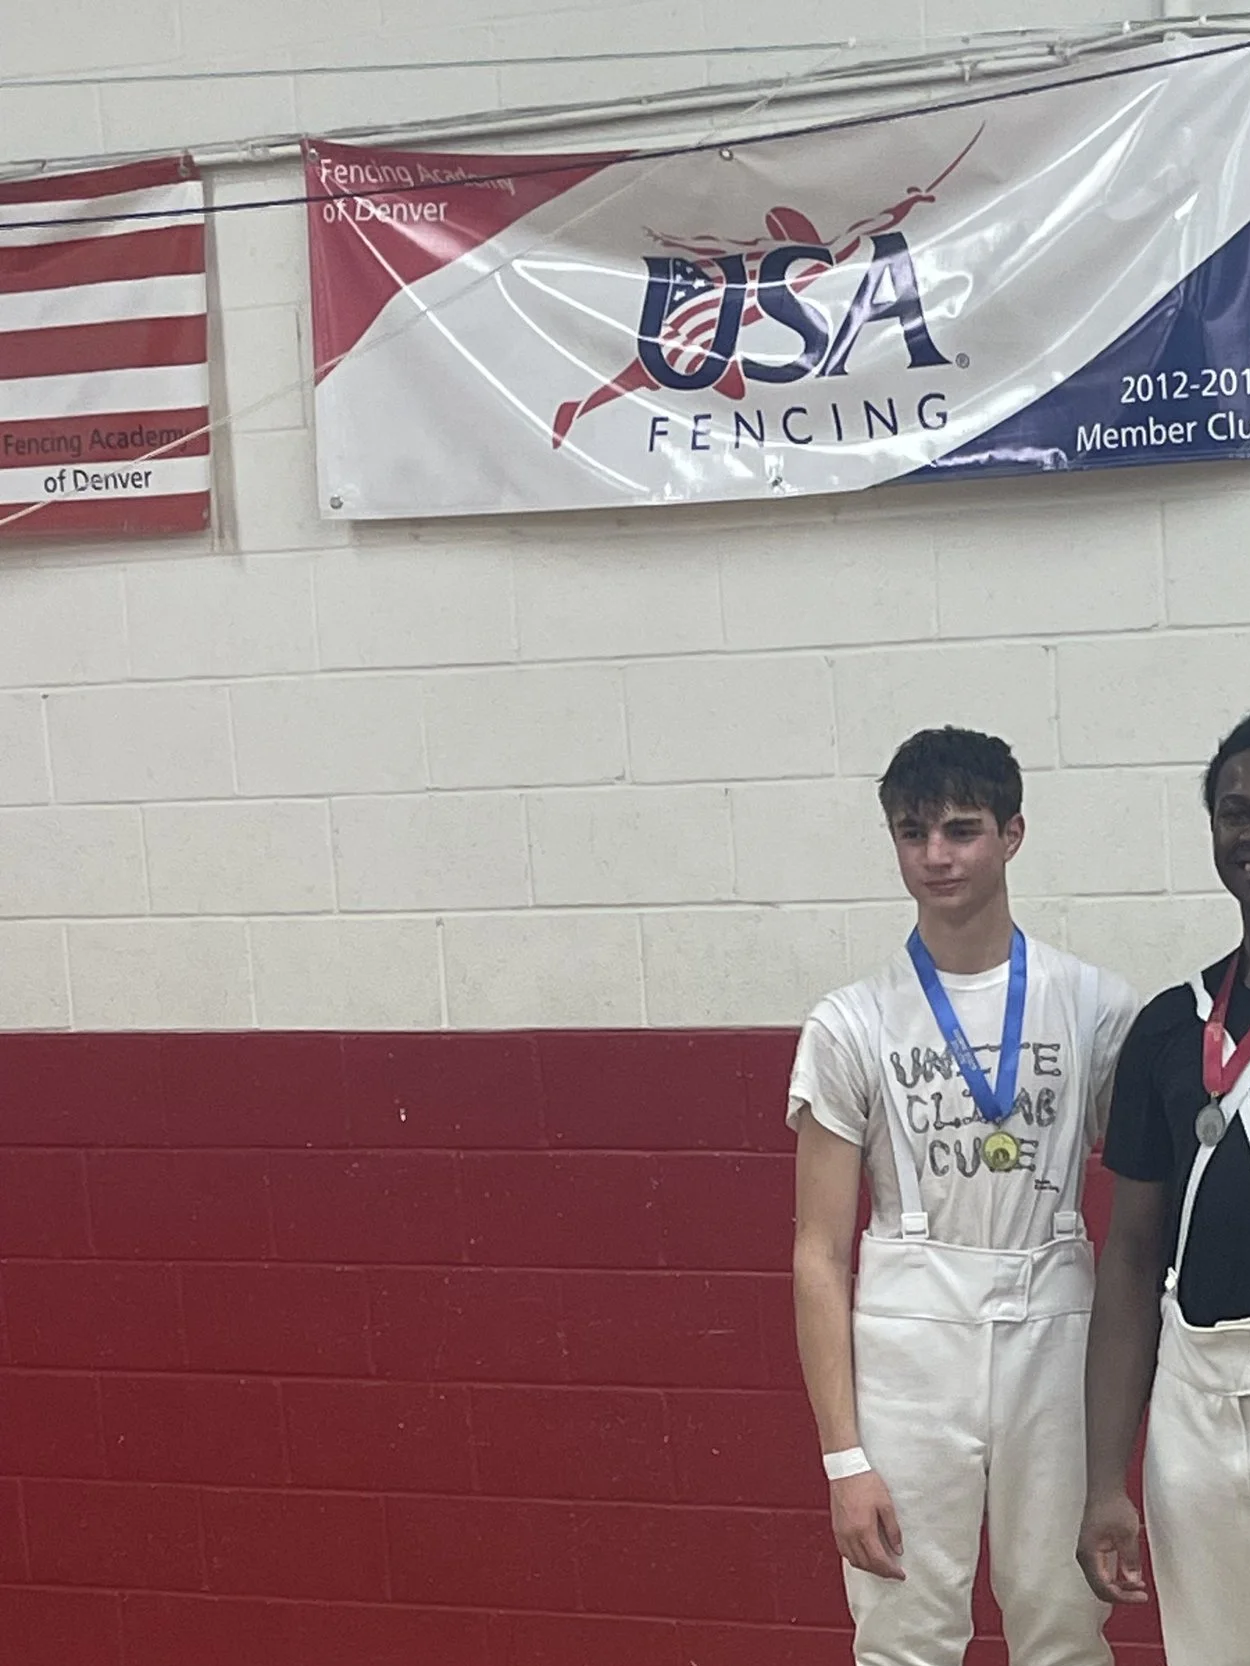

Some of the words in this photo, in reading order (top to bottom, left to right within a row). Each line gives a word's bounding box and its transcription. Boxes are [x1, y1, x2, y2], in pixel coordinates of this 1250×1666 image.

[320, 158, 415, 188] Fencing
[322, 198, 346, 224] of
[354, 197, 447, 223] Denver
[648, 392, 949, 453] FENCING
[1076, 415, 1199, 452] Member
[3, 433, 82, 458] Fencing
[89, 424, 190, 454] Academy
[44, 468, 67, 493] of
[73, 469, 152, 492] Denver
[890, 1041, 1062, 1089] UNE
[929, 1136, 1039, 1179] CUE
